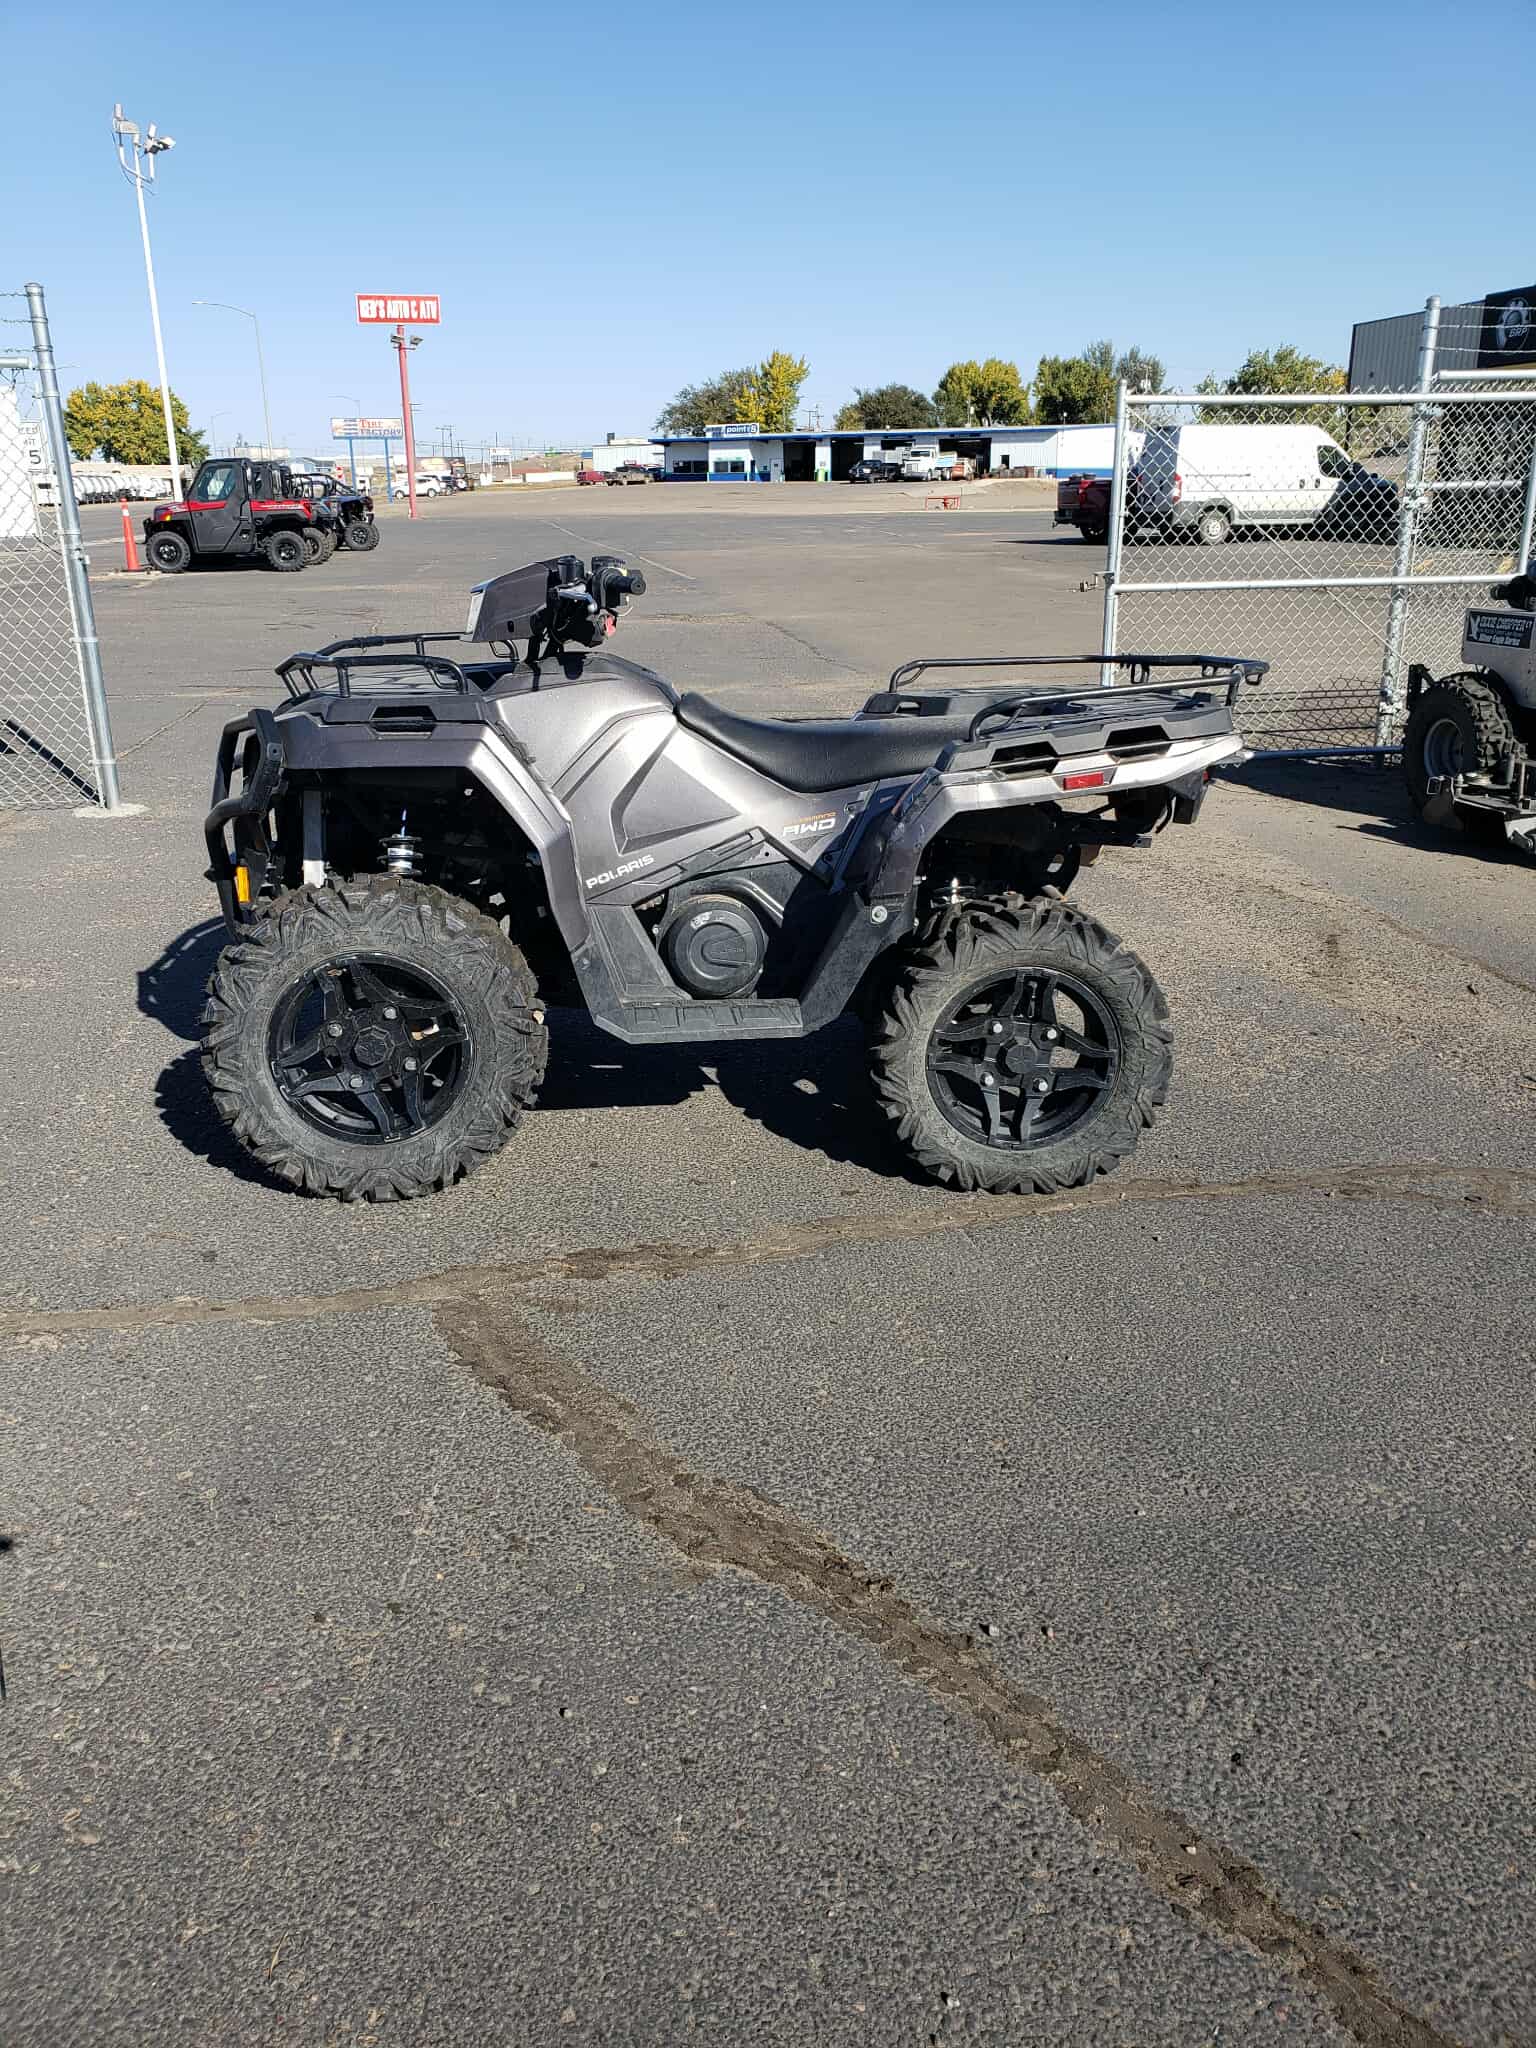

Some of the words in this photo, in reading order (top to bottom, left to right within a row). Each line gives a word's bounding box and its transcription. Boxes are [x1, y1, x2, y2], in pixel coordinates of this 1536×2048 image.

[387, 300, 409, 318] AUTO
[419, 300, 437, 319] ATV
[726, 425, 746, 434] point
[782, 817, 836, 837] AWD
[585, 854, 654, 888] POLARIS
